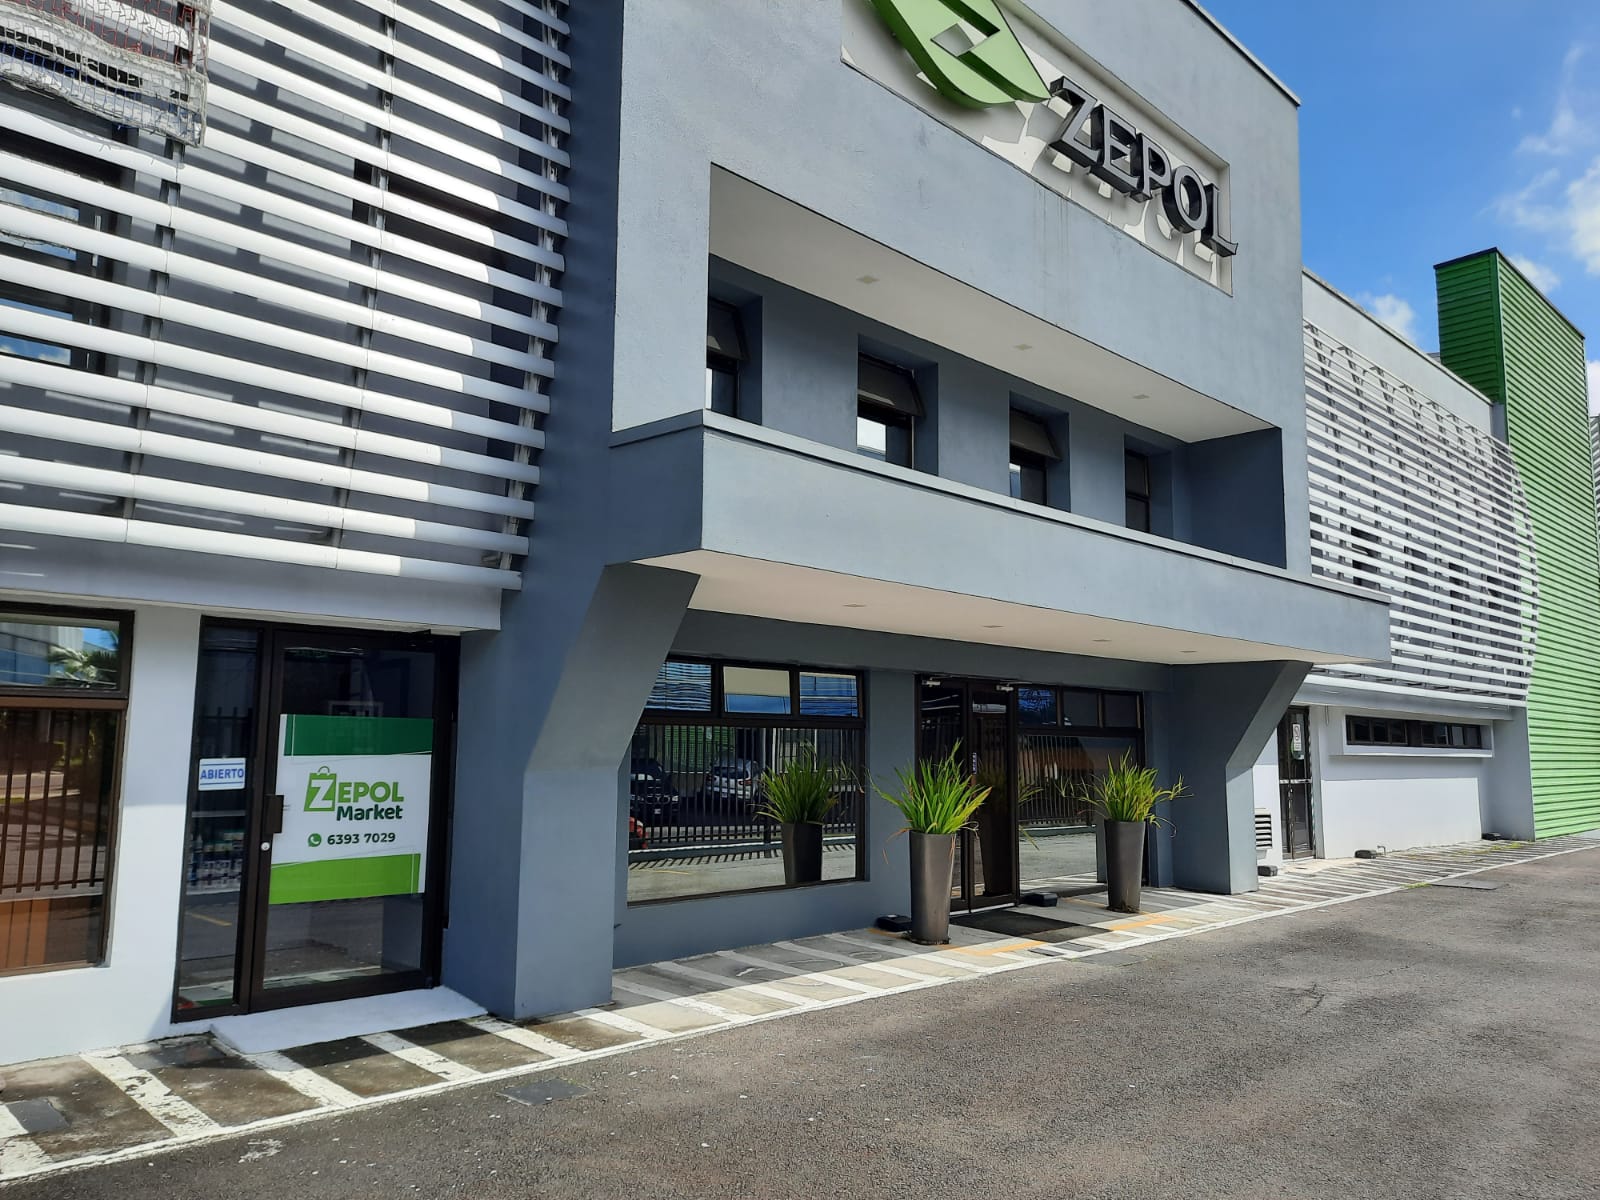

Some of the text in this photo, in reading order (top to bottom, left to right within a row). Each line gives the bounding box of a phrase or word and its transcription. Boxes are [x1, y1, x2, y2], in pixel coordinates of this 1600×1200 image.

[1050, 76, 1238, 257] ZEPOL
[200, 768, 245, 780] ABIERTO
[307, 779, 405, 809] ZEPOL
[336, 804, 404, 821] Market
[327, 832, 396, 845] 6393 7029
